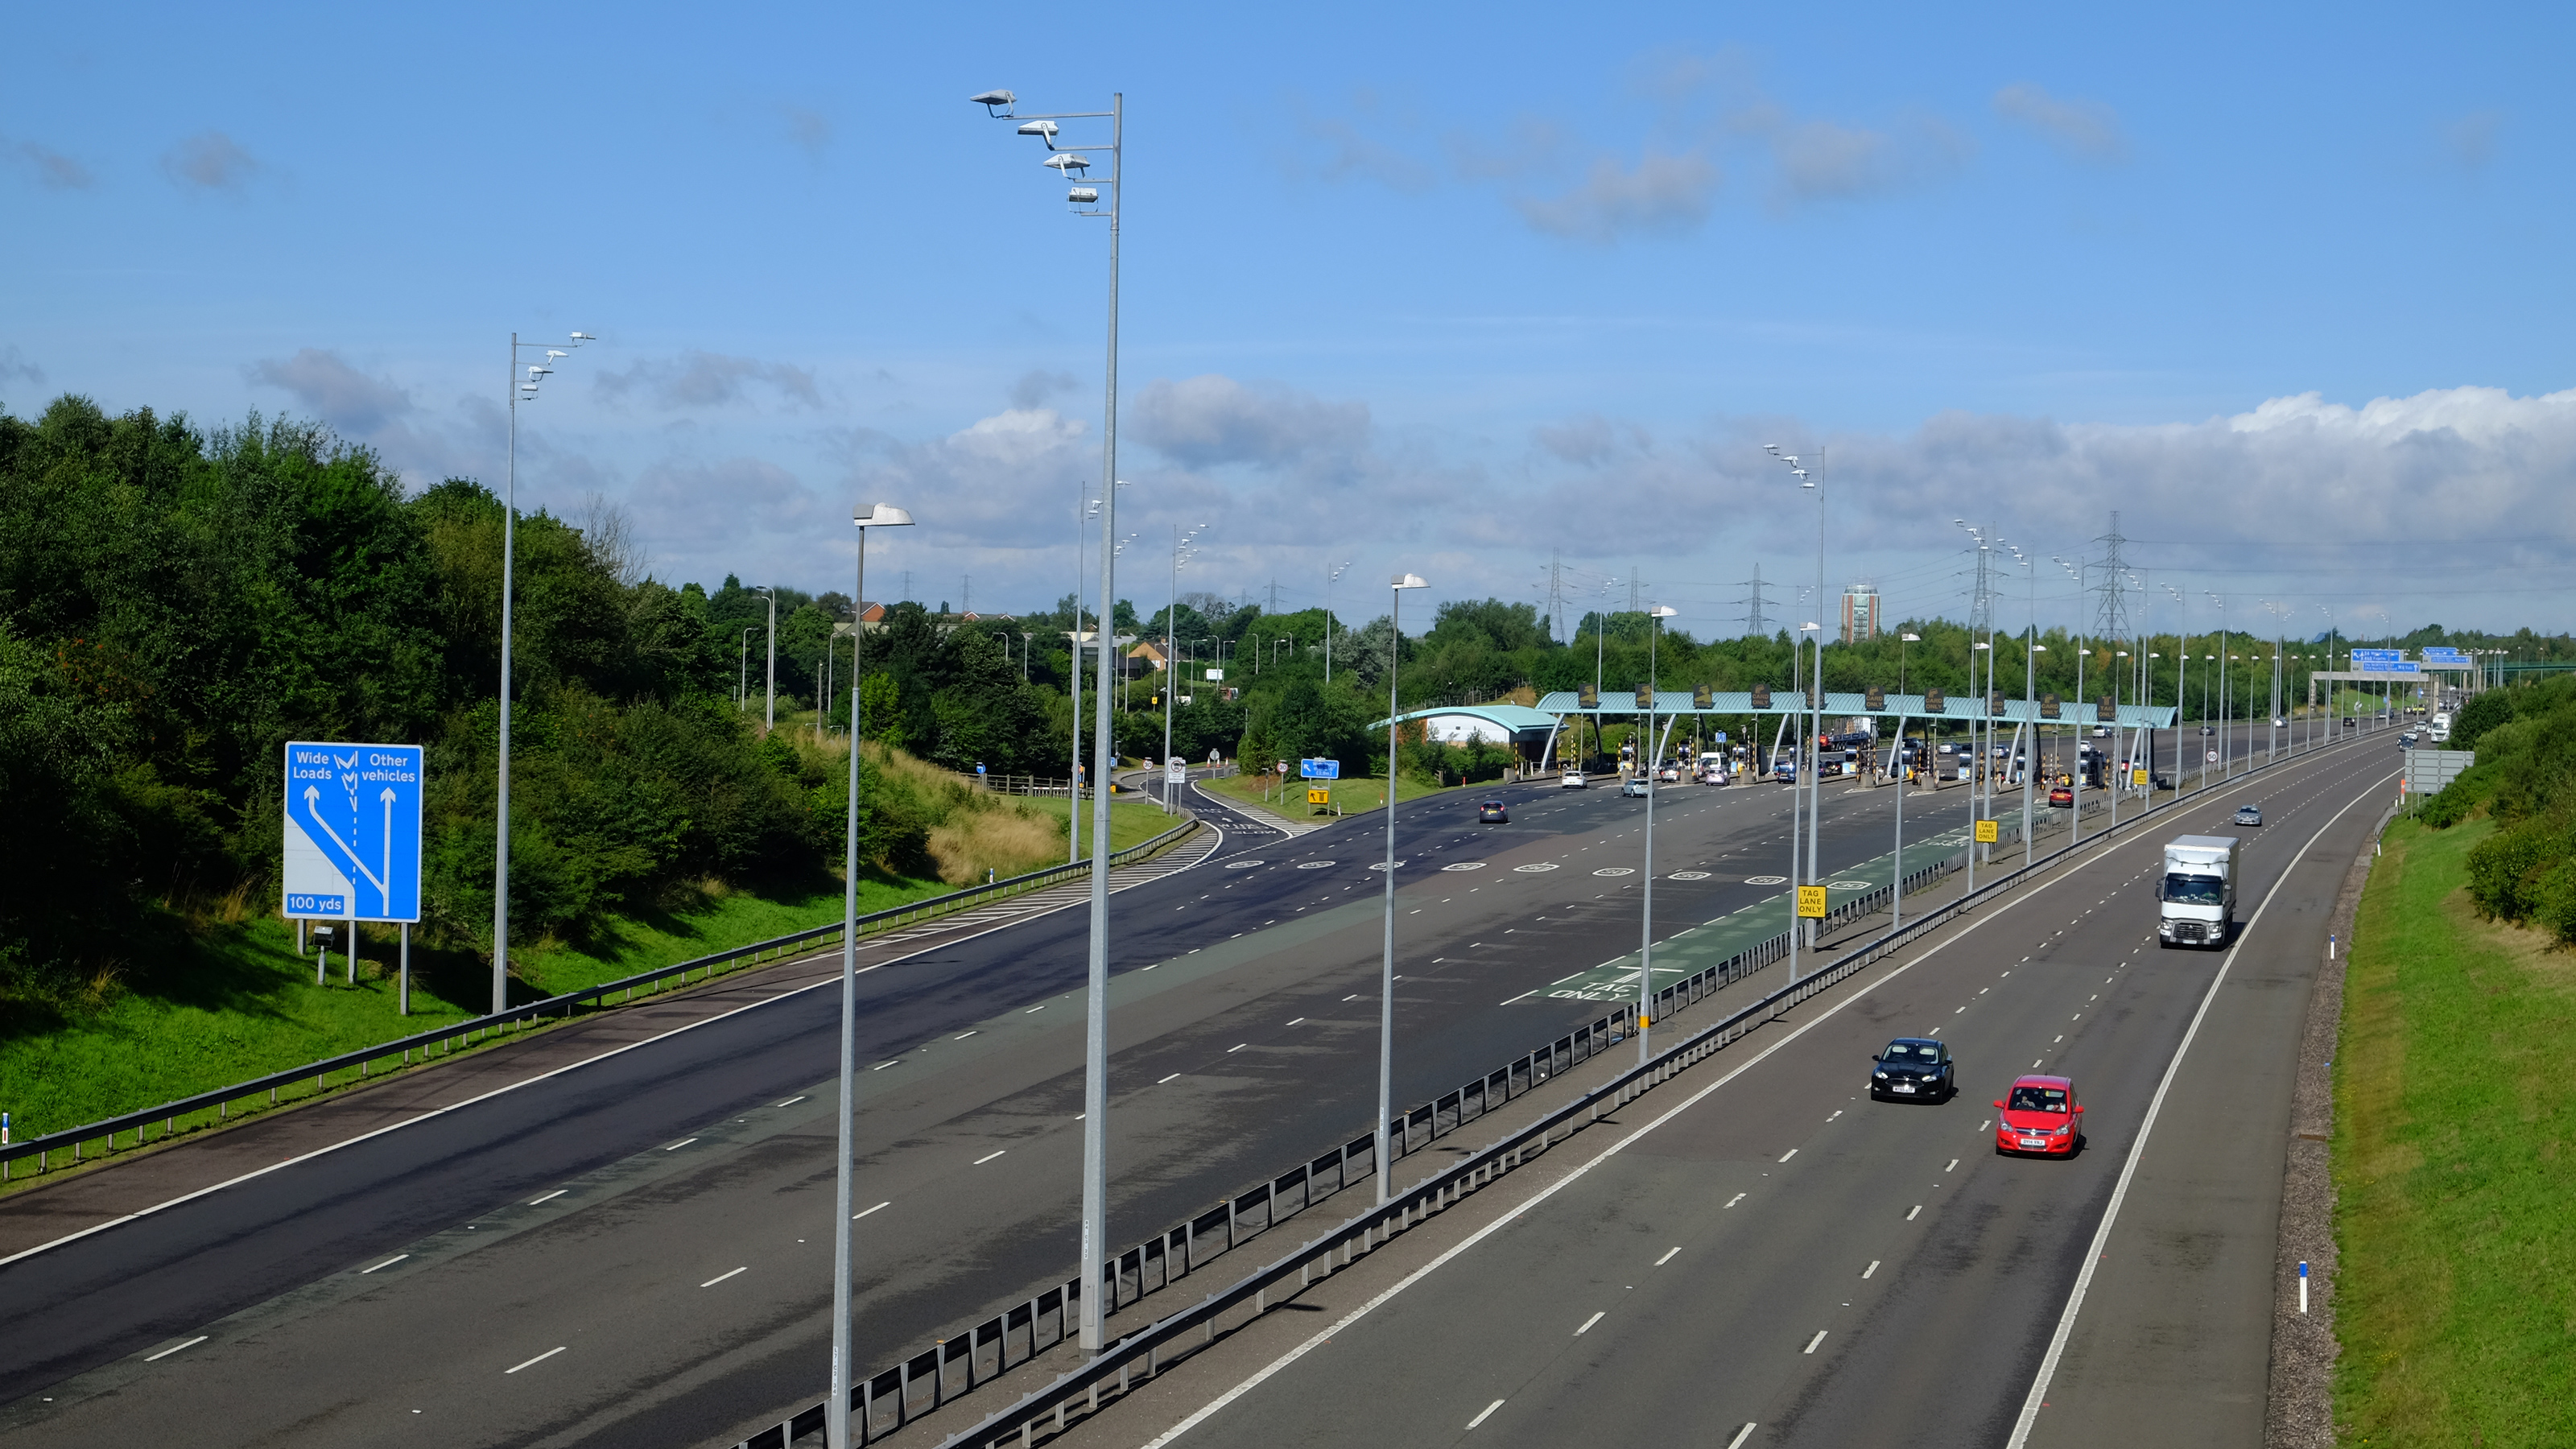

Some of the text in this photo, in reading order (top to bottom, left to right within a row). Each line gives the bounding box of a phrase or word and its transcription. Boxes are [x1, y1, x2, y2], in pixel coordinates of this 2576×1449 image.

[295, 751, 330, 764] Wide
[369, 753, 408, 767] Other
[293, 766, 332, 780] Loads
[361, 770, 415, 782] vehicles
[290, 896, 341, 912] 100 yds
[1581, 982, 1639, 993] TAG
[1547, 989, 1631, 1001] ONLY
